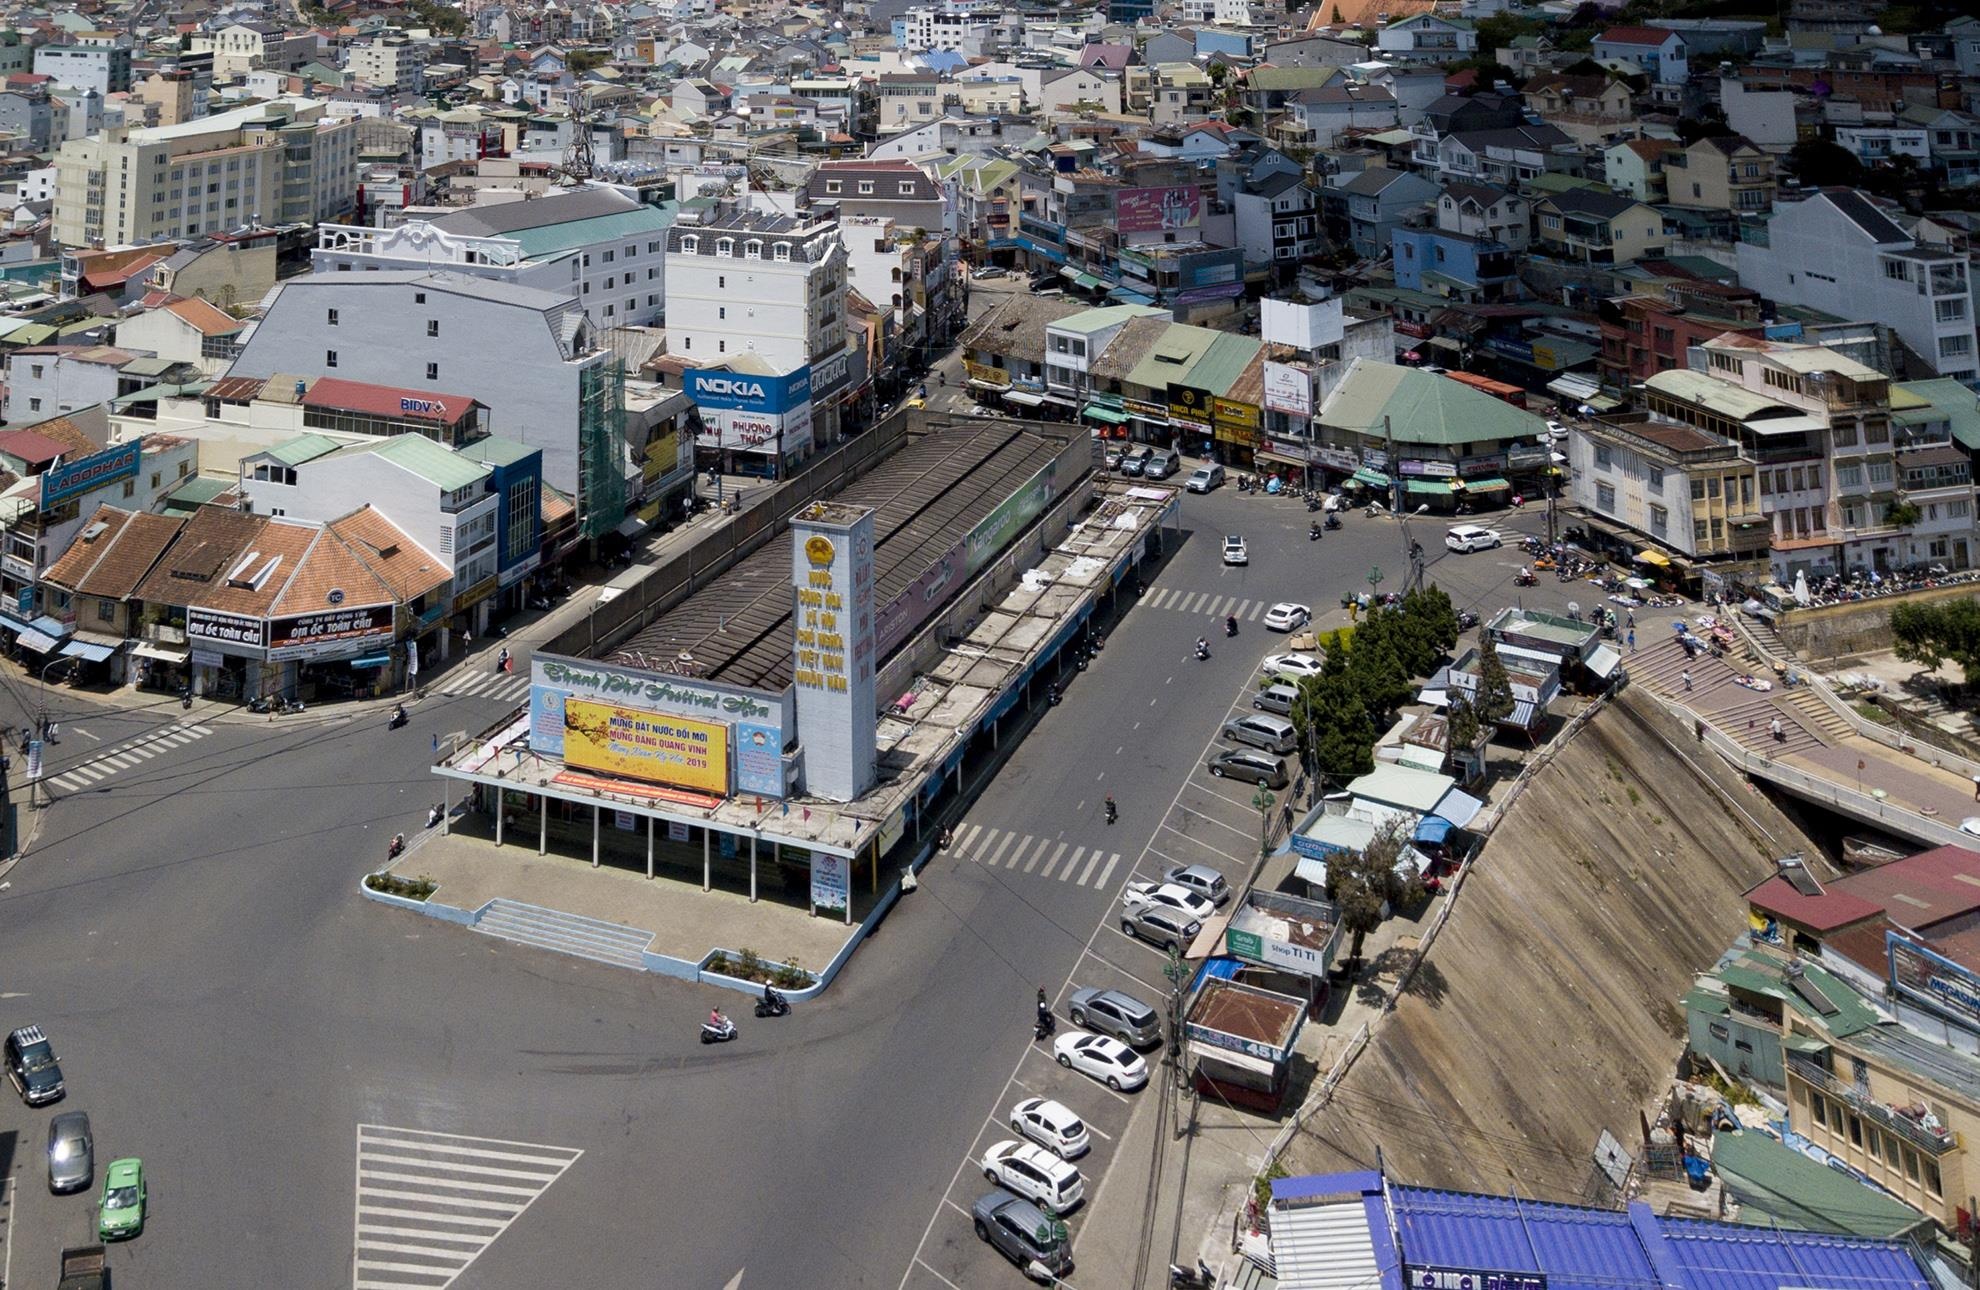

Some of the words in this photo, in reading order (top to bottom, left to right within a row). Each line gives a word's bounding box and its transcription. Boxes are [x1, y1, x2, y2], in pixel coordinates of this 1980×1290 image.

[695, 377, 766, 398] NOKIA
[401, 398, 432, 413] BIDV
[48, 453, 134, 493] LADOPHAR
[190, 622, 204, 634] ĐỊA
[205, 622, 218, 636] ỐC
[219, 627, 242, 640] TOÀN
[242, 629, 260, 643] CẦU
[290, 626, 308, 639] ĐỊA
[310, 623, 323, 634] ỐC
[327, 620, 351, 633] TOÀN
[353, 617, 373, 629] CẦU
[879, 608, 908, 640] ARISTON
[644, 683, 721, 710] Festival
[609, 717, 633, 729] MỪNG
[635, 721, 650, 732] ĐẤT
[652, 724, 674, 737] NƯỚC
[676, 727, 690, 740] ĐỔI
[692, 731, 708, 743] MỚI
[609, 729, 633, 742] MỪNG
[635, 733, 657, 746] ĐẢNG
[659, 739, 686, 752] QUANG
[688, 744, 708, 756] VINH
[686, 757, 708, 769] 2019
[1235, 934, 1254, 945] Grab
[1271, 944, 1291, 956] Shop
[1291, 947, 1303, 958] Ti
[1305, 950, 1316, 962] Ti
